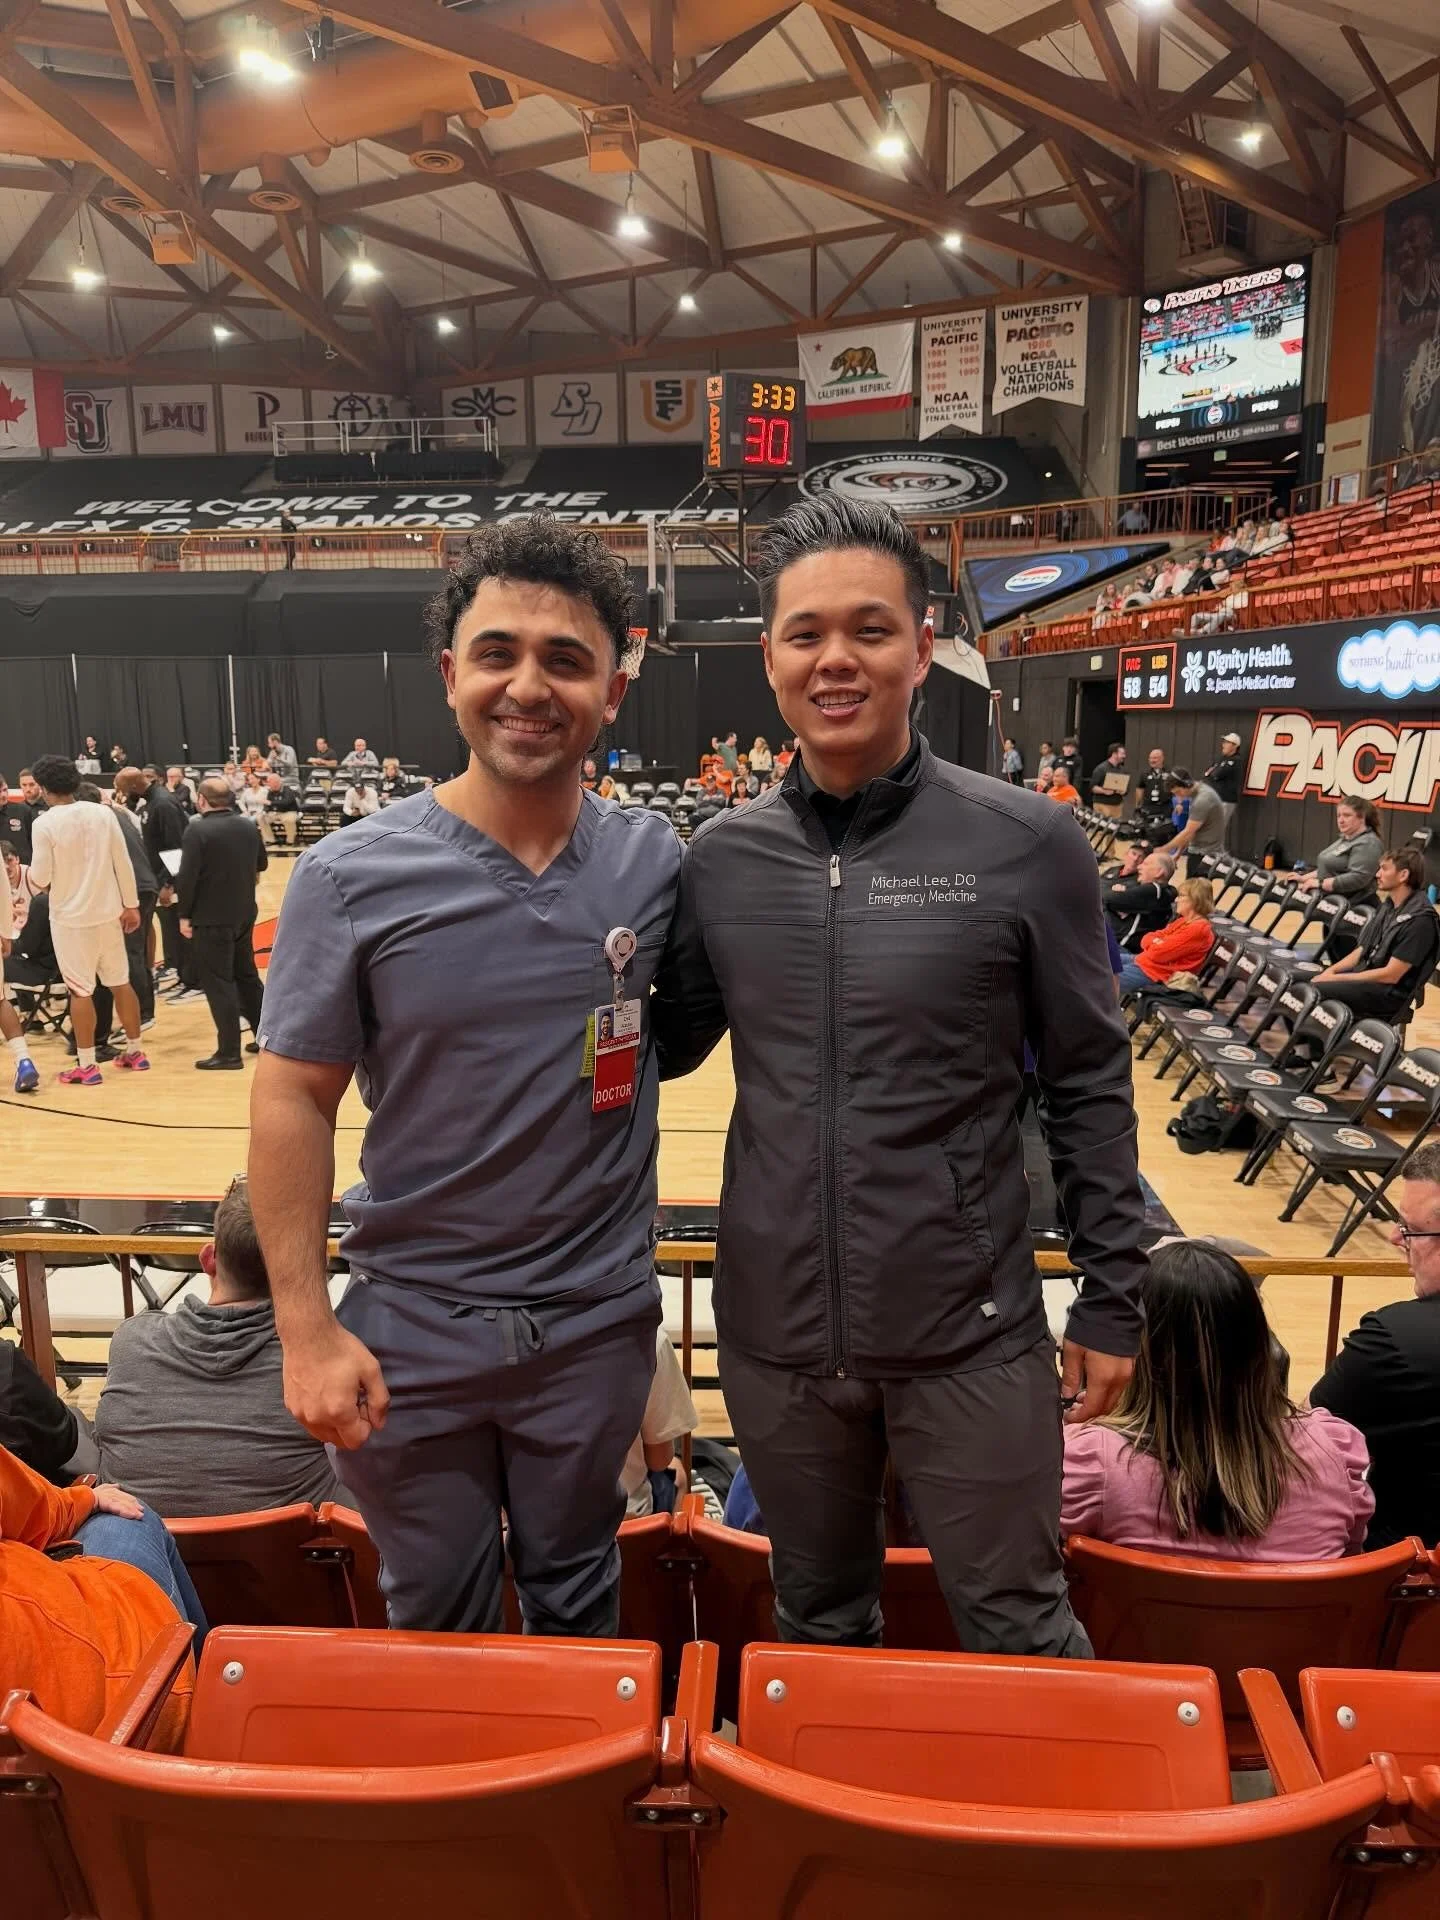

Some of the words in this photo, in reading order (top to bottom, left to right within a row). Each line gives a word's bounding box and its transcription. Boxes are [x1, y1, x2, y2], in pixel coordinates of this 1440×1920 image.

[1001, 301, 1083, 321] UNIVERSITY
[1024, 318, 1036, 326] OF
[1040, 316, 1057, 324] THE
[923, 316, 984, 332] UNIVERSITY
[1006, 321, 1075, 344] PACIFIC
[931, 332, 979, 347] PACIFIC
[1021, 349, 1058, 362] NCAA
[1001, 358, 1077, 376] VOLLEYBALL
[1008, 370, 1069, 385] NATIONAL
[752, 383, 796, 411] 3:33
[934, 392, 969, 404] NCAA
[1003, 380, 1075, 397] CHAMPIONS
[250, 391, 281, 429] P
[924, 403, 978, 414] VOLLEYBALL
[926, 413, 950, 422] FINAL
[953, 411, 977, 420] FOUR
[141, 403, 207, 435] LMU
[708, 402, 721, 468] ADART
[744, 416, 789, 464] 30
[1156, 438, 1177, 451] Best
[1178, 432, 1215, 448] Western
[1216, 428, 1240, 442] PLUS
[73, 495, 379, 517] WELCOME
[393, 493, 473, 510] TO
[494, 491, 608, 511] THE
[1207, 648, 1249, 675] Dignity
[1123, 676, 1142, 698] 58
[1149, 675, 1168, 698] 54
[1243, 674, 1270, 690] Medical
[1270, 675, 1296, 689] Center
[871, 875, 921, 889] Michael
[924, 874, 951, 888] Lee,
[954, 873, 976, 886] DO
[868, 892, 926, 907] Emergency
[928, 889, 977, 903] Medicine
[1350, 1029, 1385, 1055] PACIFIC
[1398, 1056, 1440, 1089] PACIFIC
[595, 1082, 632, 1104] DOCTOR
